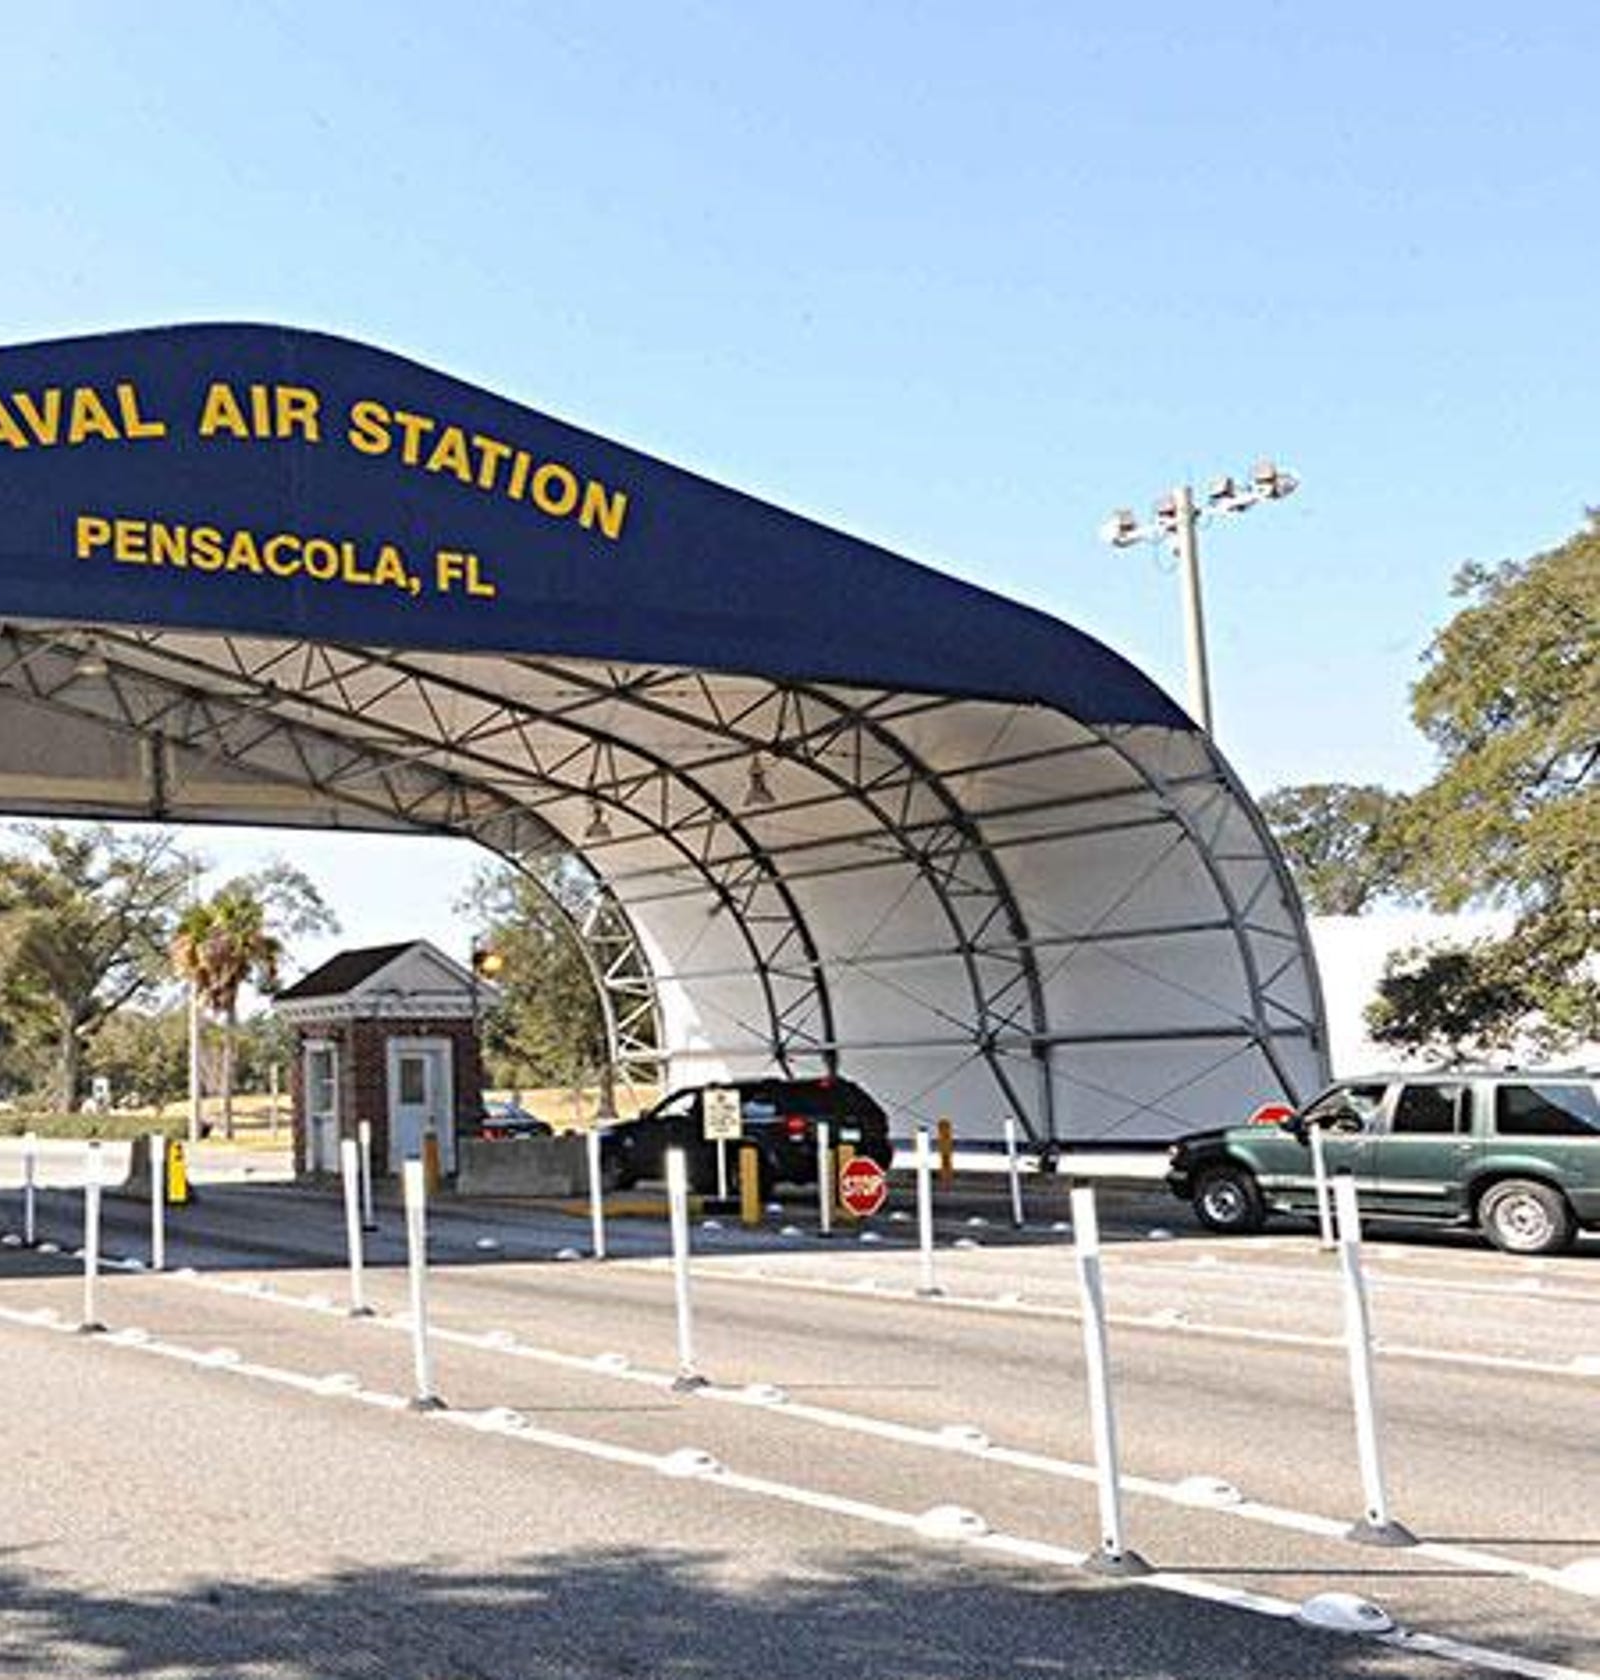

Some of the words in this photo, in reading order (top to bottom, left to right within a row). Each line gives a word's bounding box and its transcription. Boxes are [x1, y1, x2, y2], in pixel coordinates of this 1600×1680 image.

[198, 382, 320, 443] AIR
[348, 400, 628, 540] STATION
[76, 516, 422, 596] PENSACOLA,
[436, 551, 497, 597] FL
[842, 1175, 882, 1197] STOP
